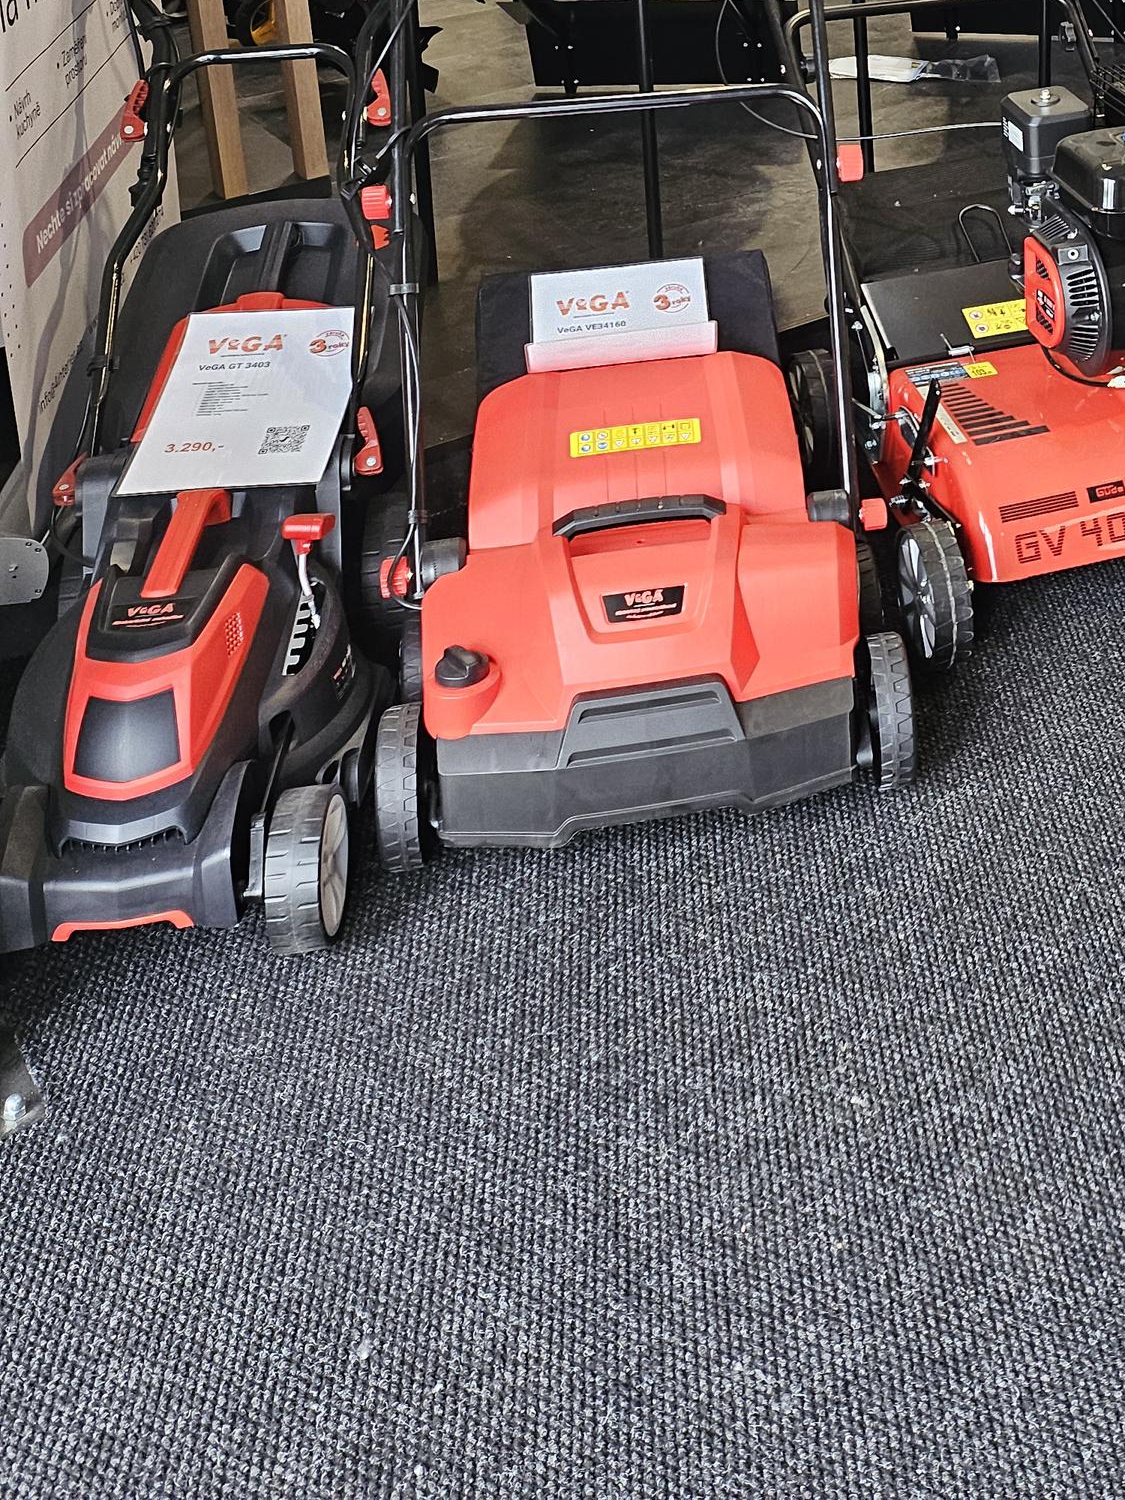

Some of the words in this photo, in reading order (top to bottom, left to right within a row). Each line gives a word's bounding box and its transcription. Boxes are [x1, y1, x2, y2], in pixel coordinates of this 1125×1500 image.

[36, 207, 65, 254] Nechte
[556, 291, 630, 316] VeGA
[654, 294, 671, 311] 3
[557, 325, 583, 334] VeGA
[585, 320, 627, 332] VE34160
[208, 333, 284, 355] VeGA
[309, 338, 327, 355] 3
[199, 363, 226, 371] VeGA
[228, 362, 244, 370] GT
[245, 361, 271, 369] 3403
[164, 441, 225, 454] 3.290,-
[1015, 525, 1066, 564] GV
[624, 589, 664, 606] VeGA
[127, 602, 174, 617] VeGA
